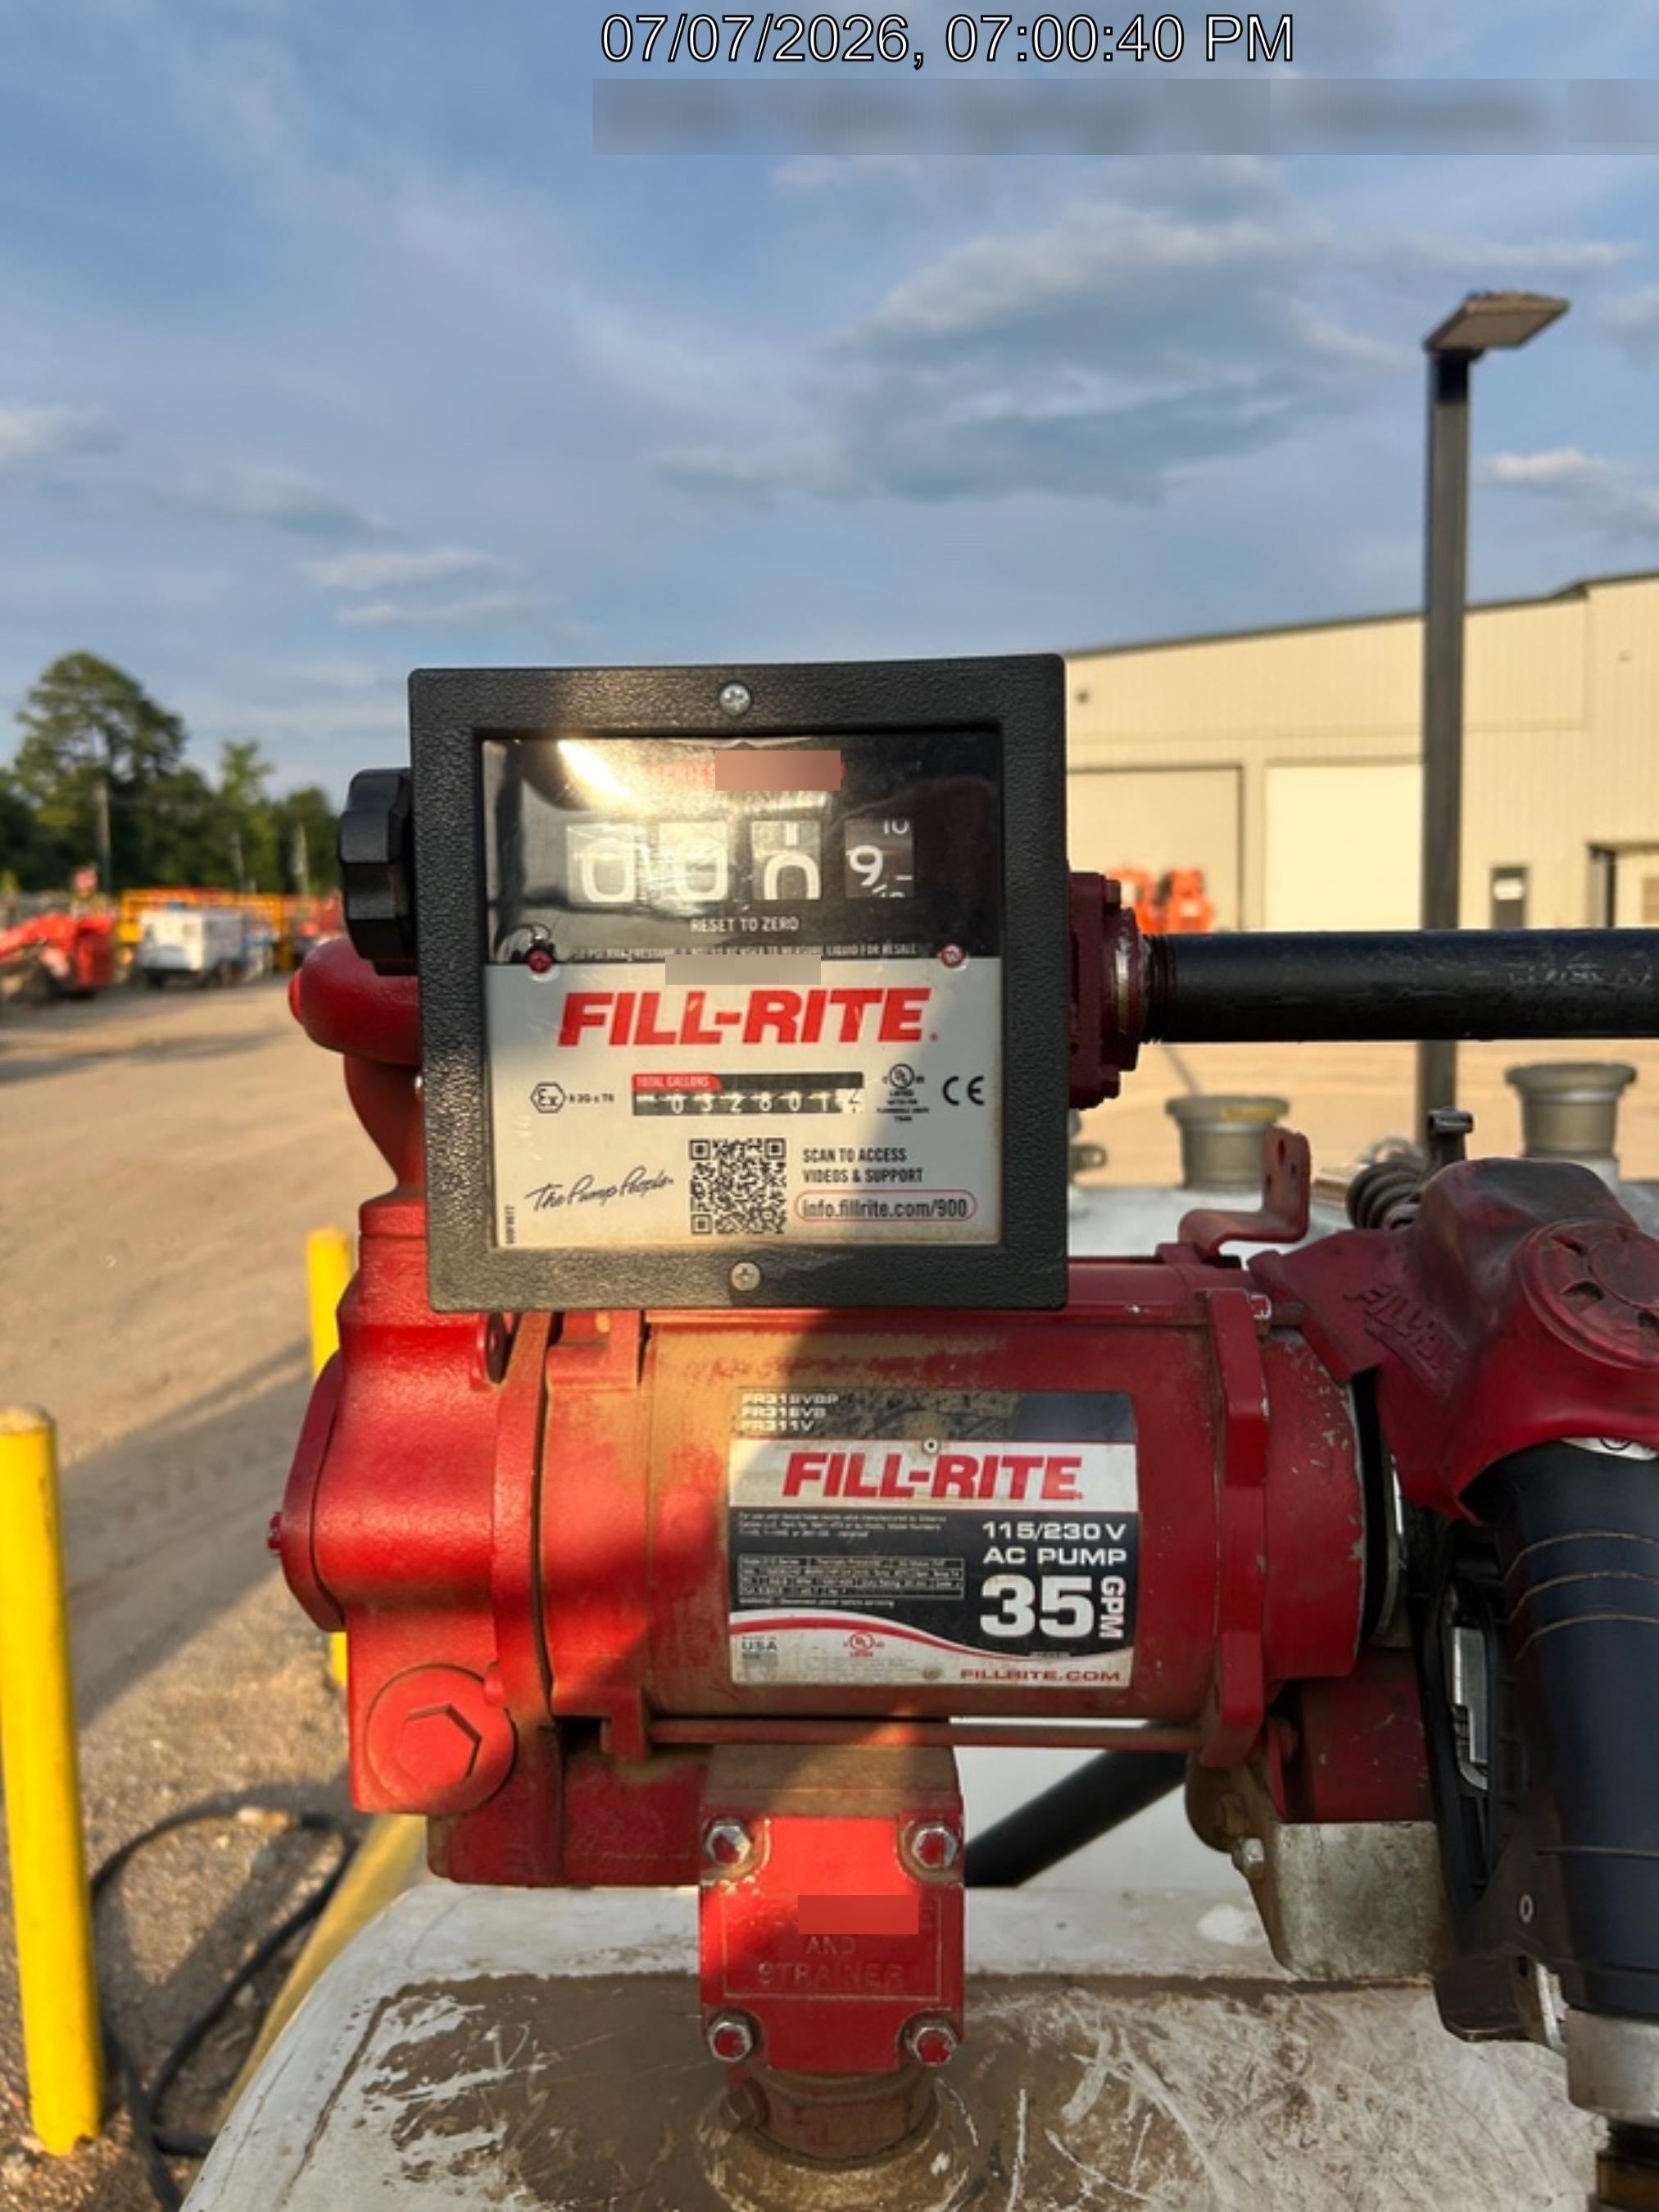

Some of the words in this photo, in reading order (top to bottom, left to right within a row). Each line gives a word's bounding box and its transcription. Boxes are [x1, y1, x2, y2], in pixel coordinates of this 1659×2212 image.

[690, 918, 733, 932] RESET
[740, 918, 758, 932] TO
[762, 917, 800, 932] ZERO
[559, 987, 931, 1046] FILL-RITE
[802, 1147, 836, 1163] SCAN
[838, 1147, 855, 1163] TO
[858, 1147, 908, 1163] ACCESS
[802, 1168, 850, 1183] VIDEOS
[852, 1168, 861, 1182] &
[864, 1167, 924, 1182] SUPPORT
[802, 1199, 968, 1217] info.fillrite.com/900
[782, 1452, 1082, 1500] FILL-RITE
[982, 1521, 1100, 1541] 115/230
[1105, 1524, 1126, 1541] V
[983, 1546, 1026, 1565] AC
[1037, 1548, 1127, 1566] PUMP
[980, 1574, 1095, 1638] 35
[1099, 1575, 1126, 1639] GPM
[741, 1641, 777, 1651] USA
[960, 1669, 1121, 1682] FILLRITE.COM
